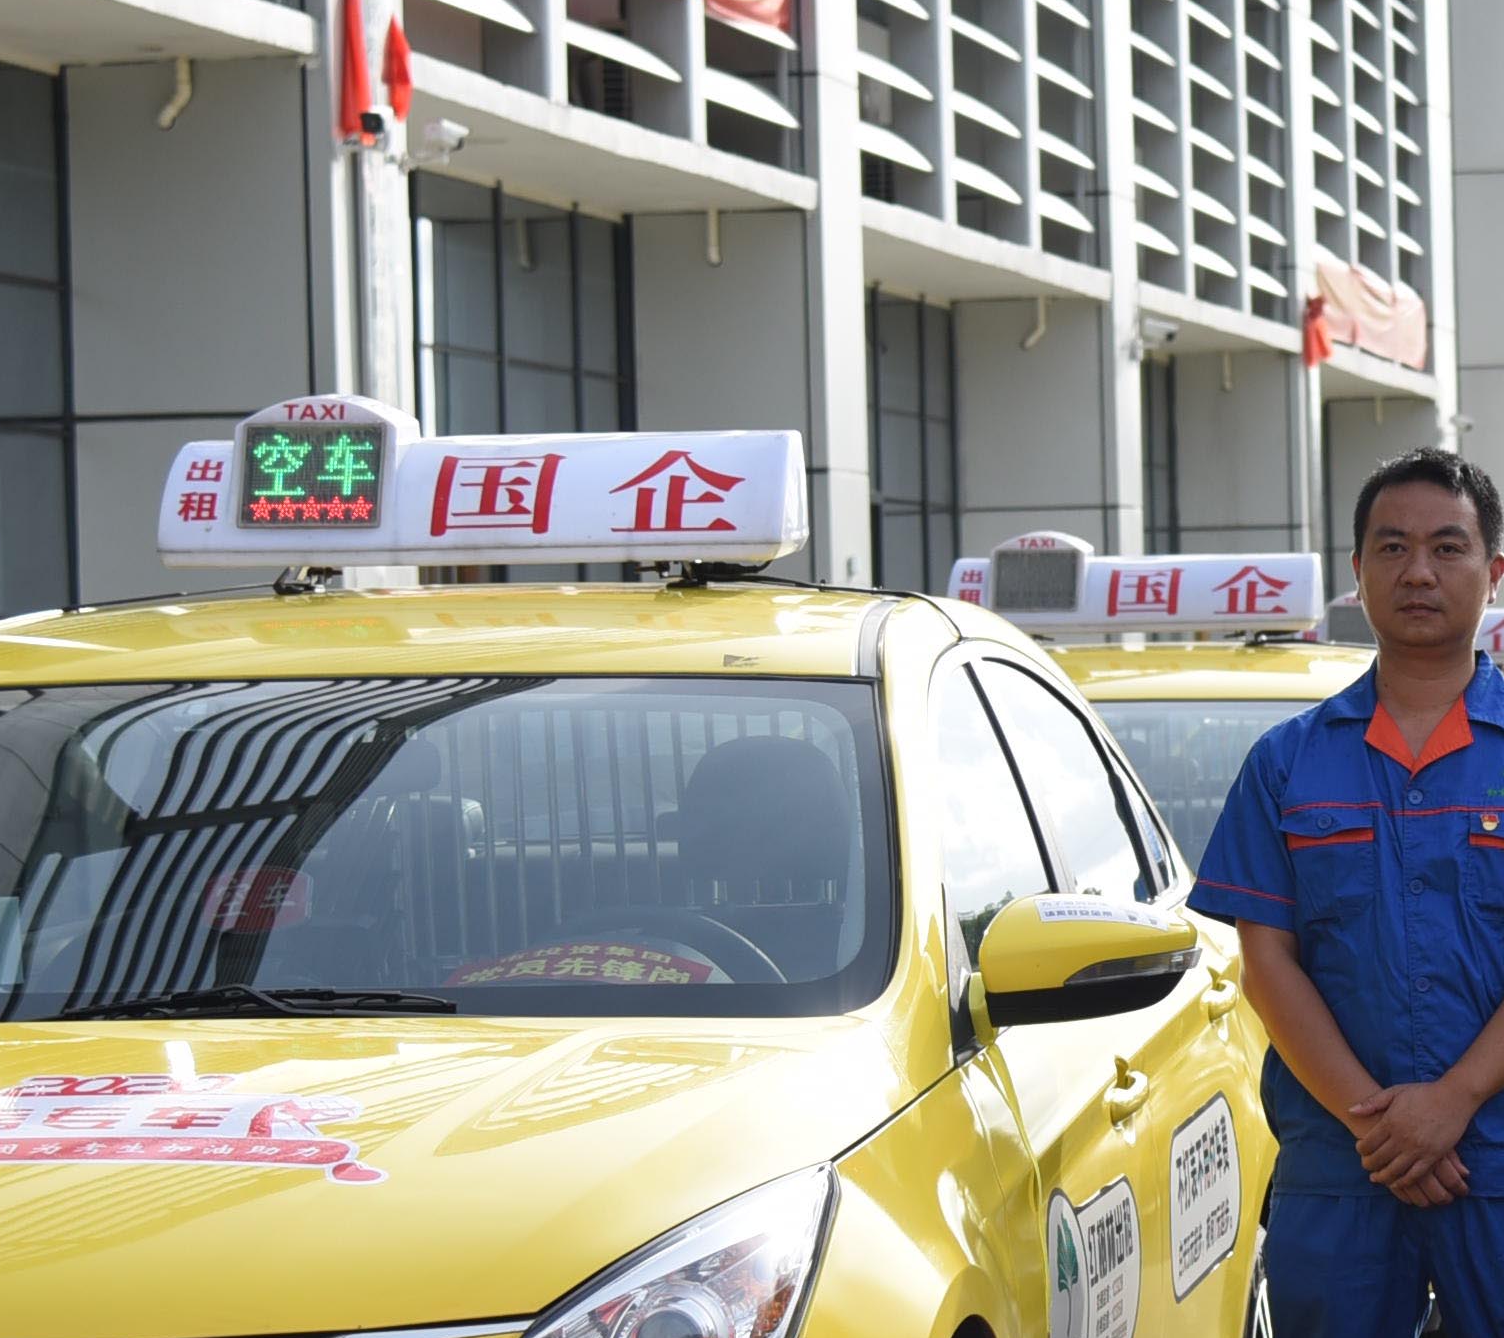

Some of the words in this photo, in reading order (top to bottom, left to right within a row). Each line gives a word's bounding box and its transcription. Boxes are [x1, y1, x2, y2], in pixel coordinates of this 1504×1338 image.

[284, 403, 346, 420] TAXI
[252, 434, 375, 498] 空车
[178, 459, 223, 521] 出租
[428, 449, 746, 537] 国企
[1018, 537, 1056, 549] TAXI
[958, 568, 984, 605] 出租
[1106, 565, 1292, 617] 国企
[457, 957, 692, 984] 党员先锋岗
